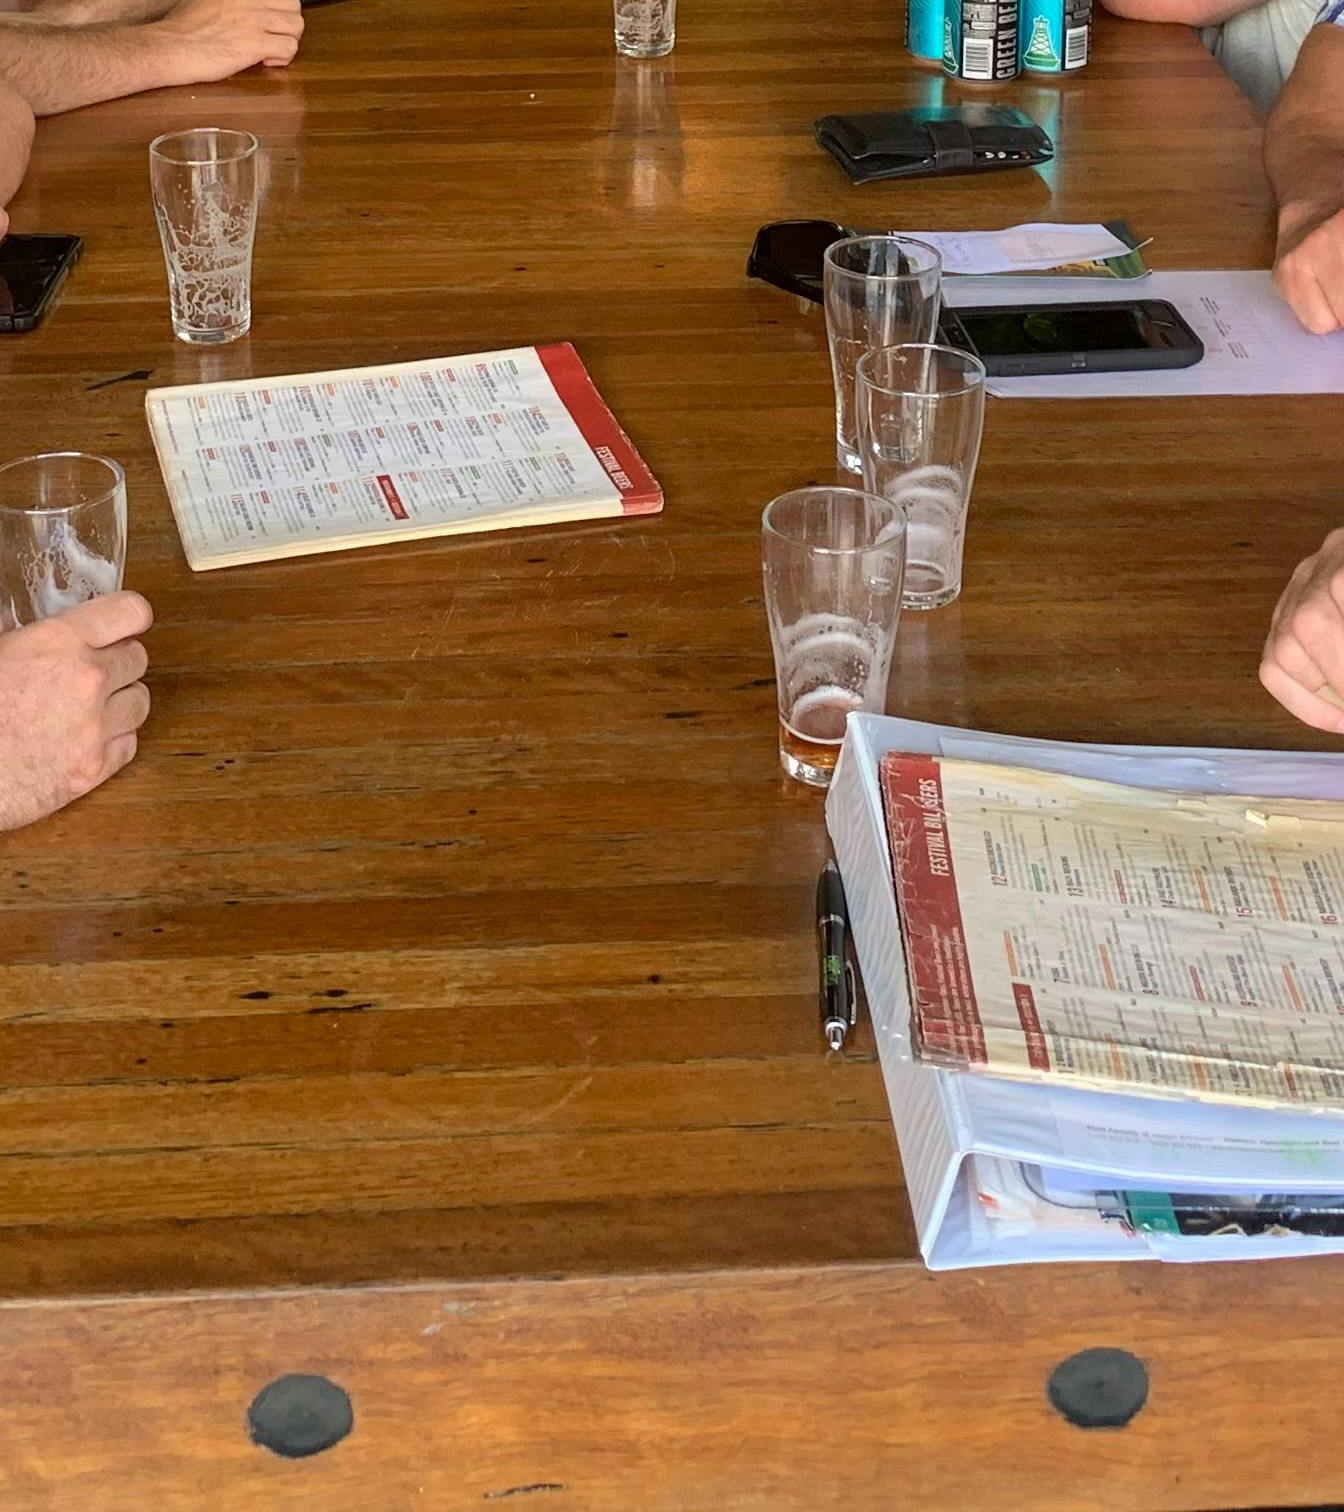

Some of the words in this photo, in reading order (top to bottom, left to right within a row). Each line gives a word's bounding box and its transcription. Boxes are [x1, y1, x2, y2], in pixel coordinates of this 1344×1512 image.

[996, 29, 1017, 79] GREEN
[595, 446, 622, 473] FESTIVAL
[610, 471, 634, 489] BEERS
[926, 832, 950, 877] FESTIVAL
[991, 875, 1009, 887] 12
[1066, 886, 1085, 897] 13
[1159, 898, 1177, 908] 14
[1234, 906, 1254, 918] 15
[1319, 913, 1339, 926] 16
